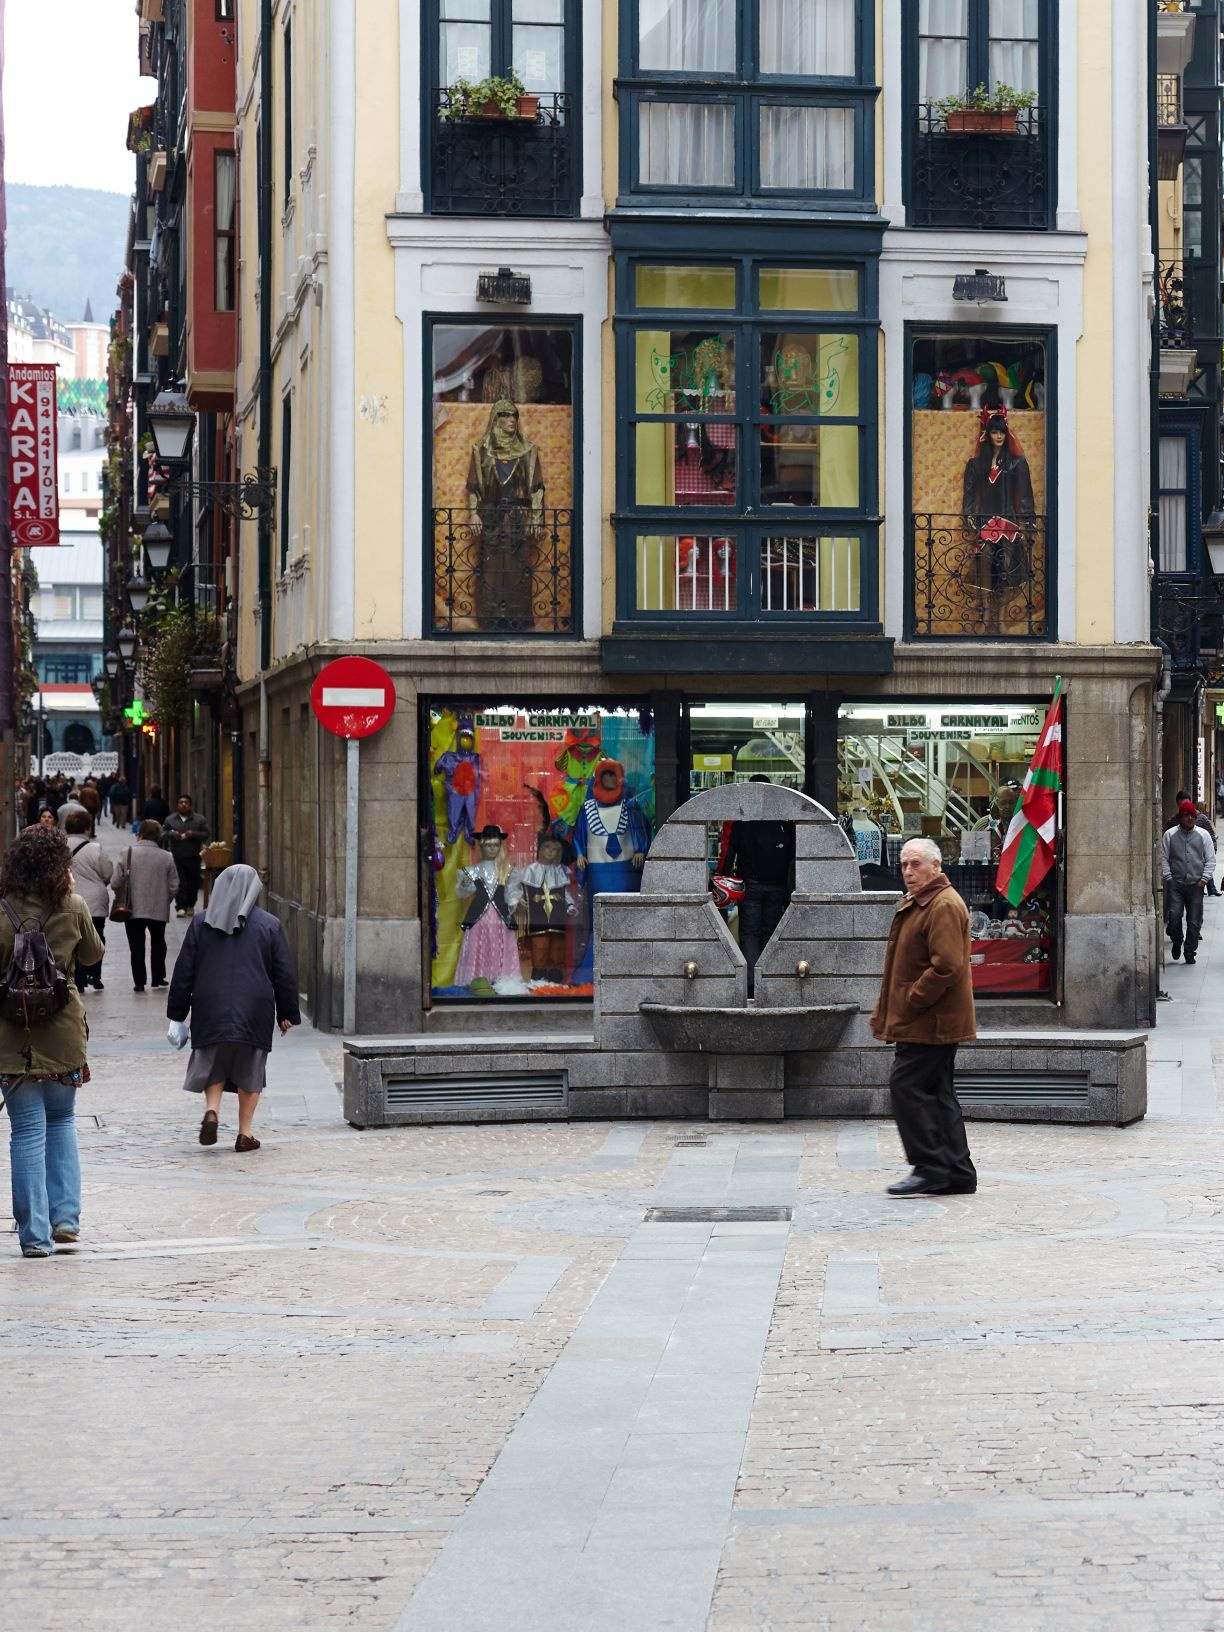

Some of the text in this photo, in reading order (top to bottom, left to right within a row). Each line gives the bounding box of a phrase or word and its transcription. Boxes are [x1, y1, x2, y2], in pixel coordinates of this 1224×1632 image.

[9, 366, 55, 381] Andamios
[40, 397, 51, 419] 94
[10, 381, 36, 510] KARPA
[42, 465, 53, 487] 70
[43, 495, 54, 517] 73
[529, 716, 596, 727] CARNAVAL
[940, 715, 1008, 727] CARNAVAL
[502, 731, 563, 740] SOUVENIRS
[910, 730, 972, 741] SOUVENIRS
